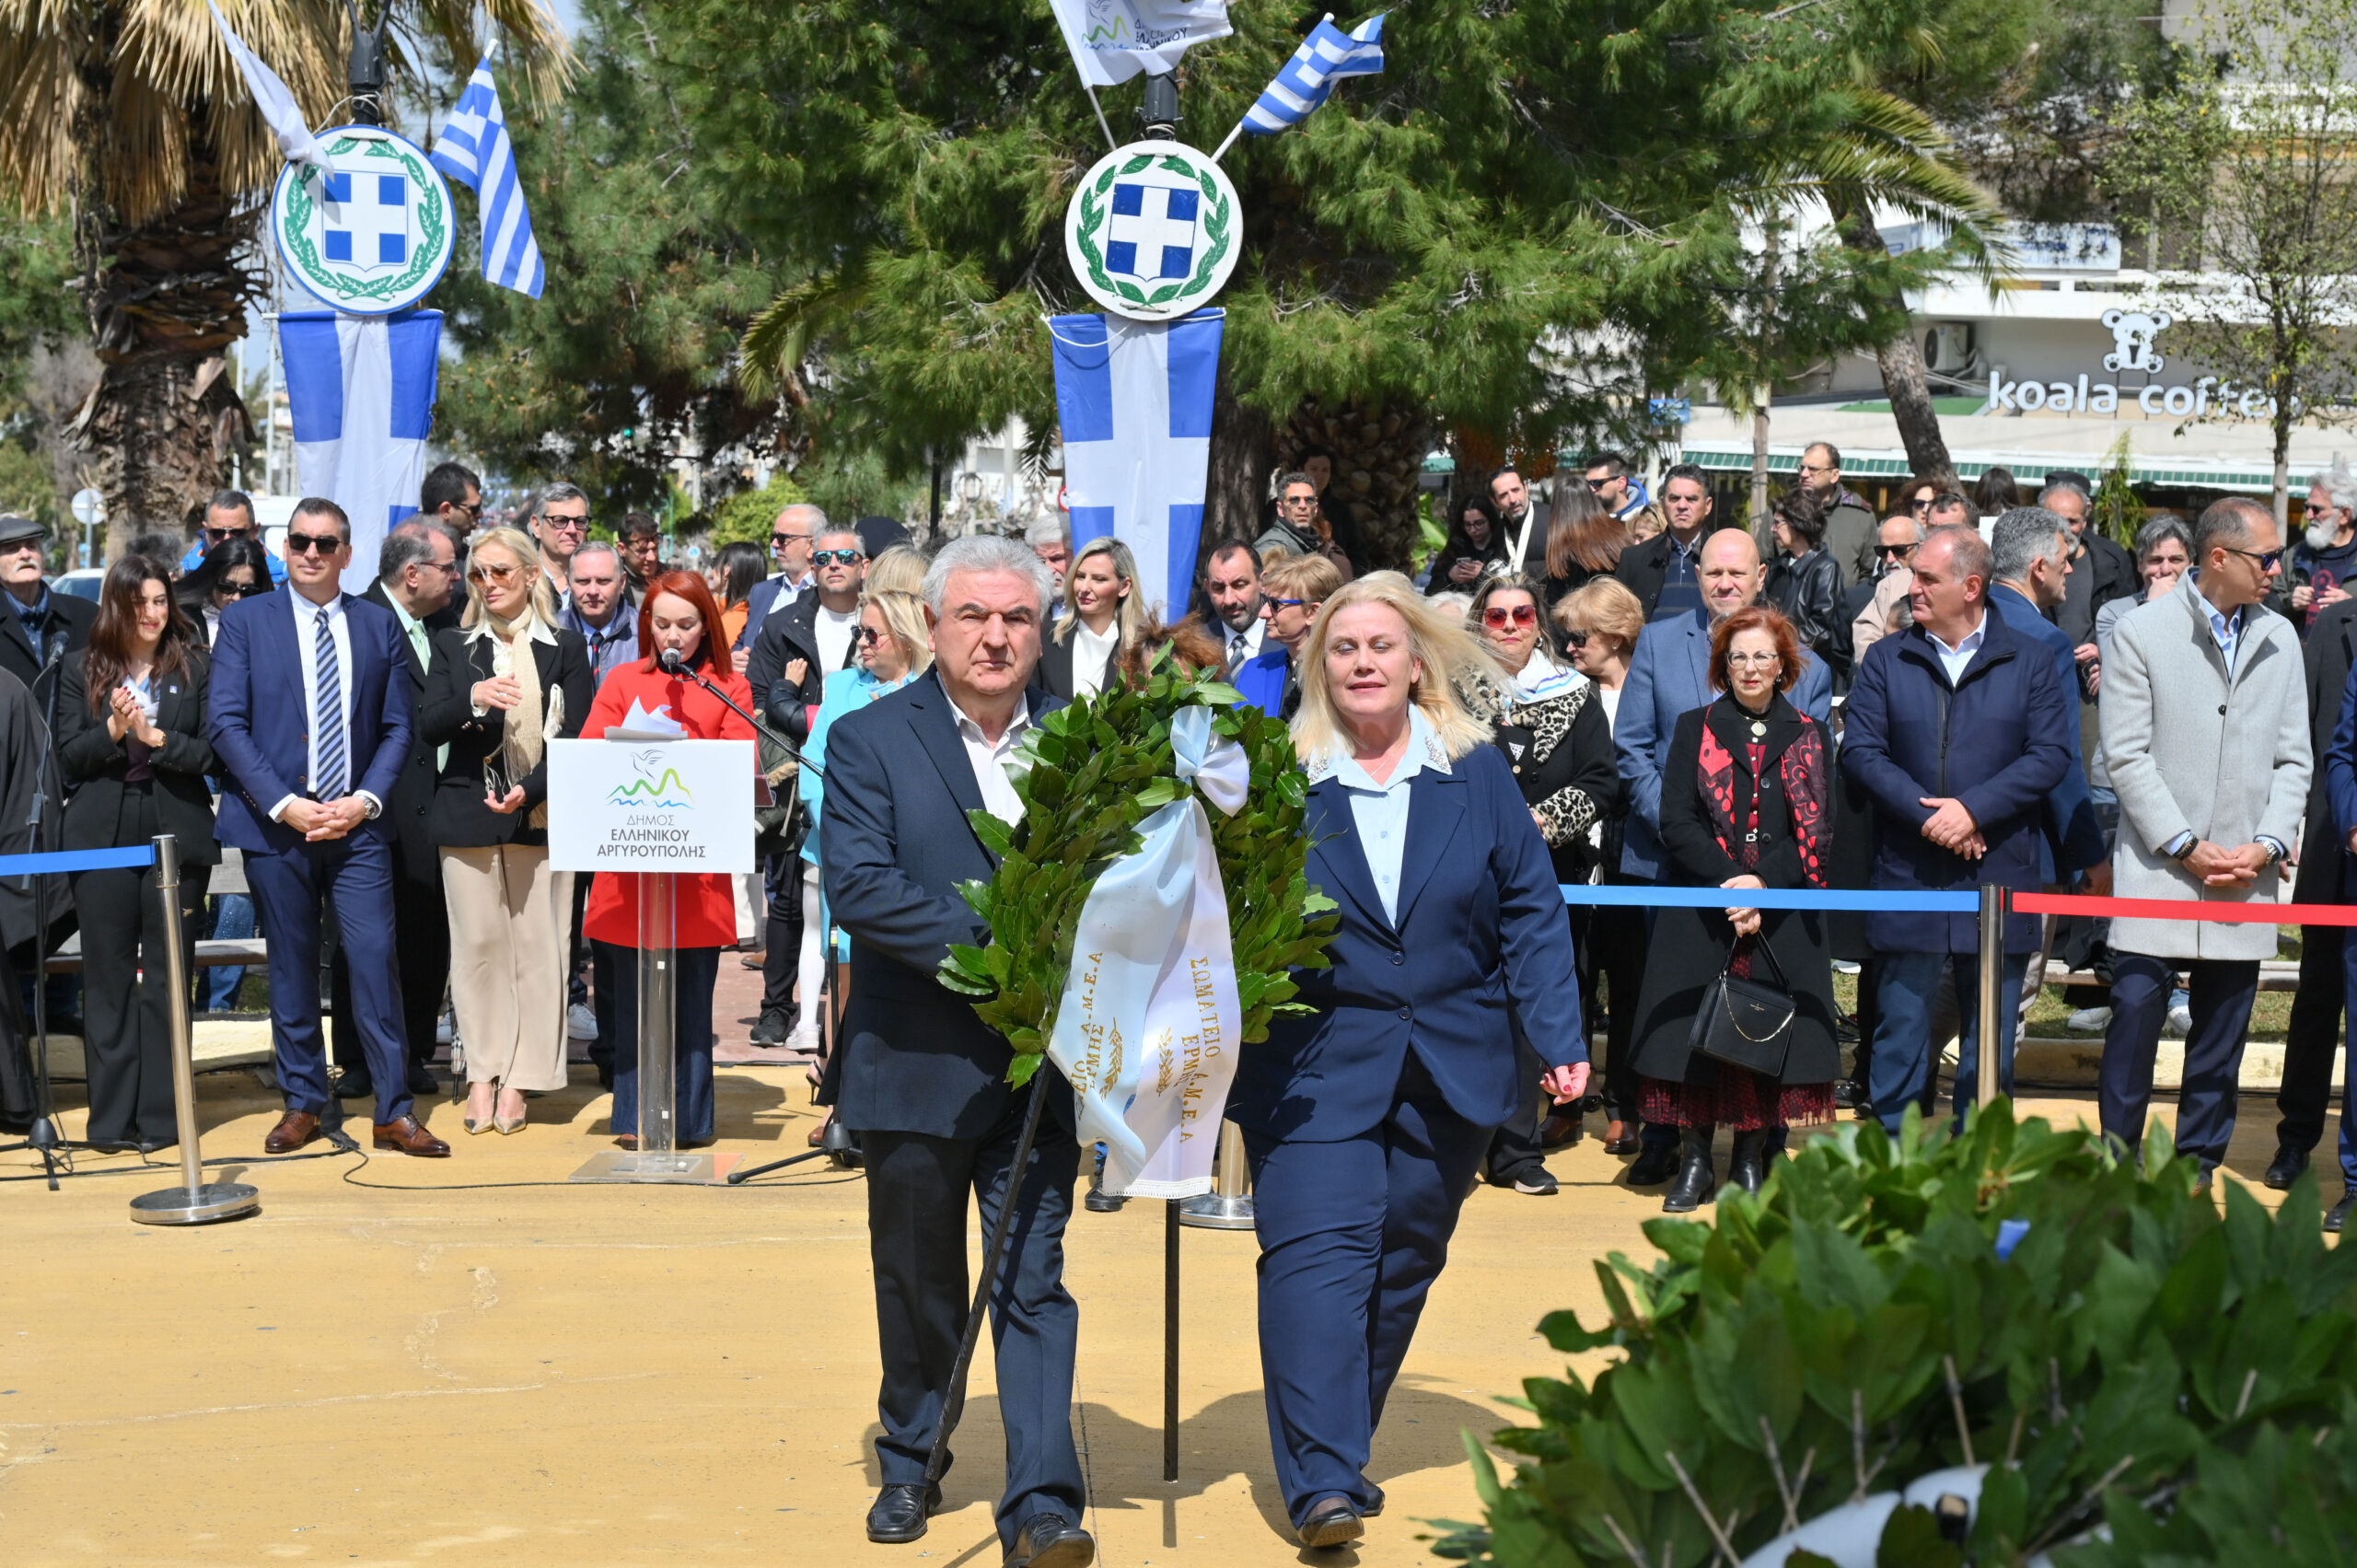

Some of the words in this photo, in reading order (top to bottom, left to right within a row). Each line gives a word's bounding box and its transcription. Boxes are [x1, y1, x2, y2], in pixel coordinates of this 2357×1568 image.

[1989, 370, 2118, 414] koala
[626, 814, 675, 826] ΔΗΜΟΣ
[610, 829, 690, 842] ΕΛΛΗΝΙΚΟΥ
[597, 844, 706, 857] ΑΡΓΥΡΟΥΠΟΛΗΣ
[1190, 957, 1221, 1059] ΣΩΜΑΤΕΙΟ
